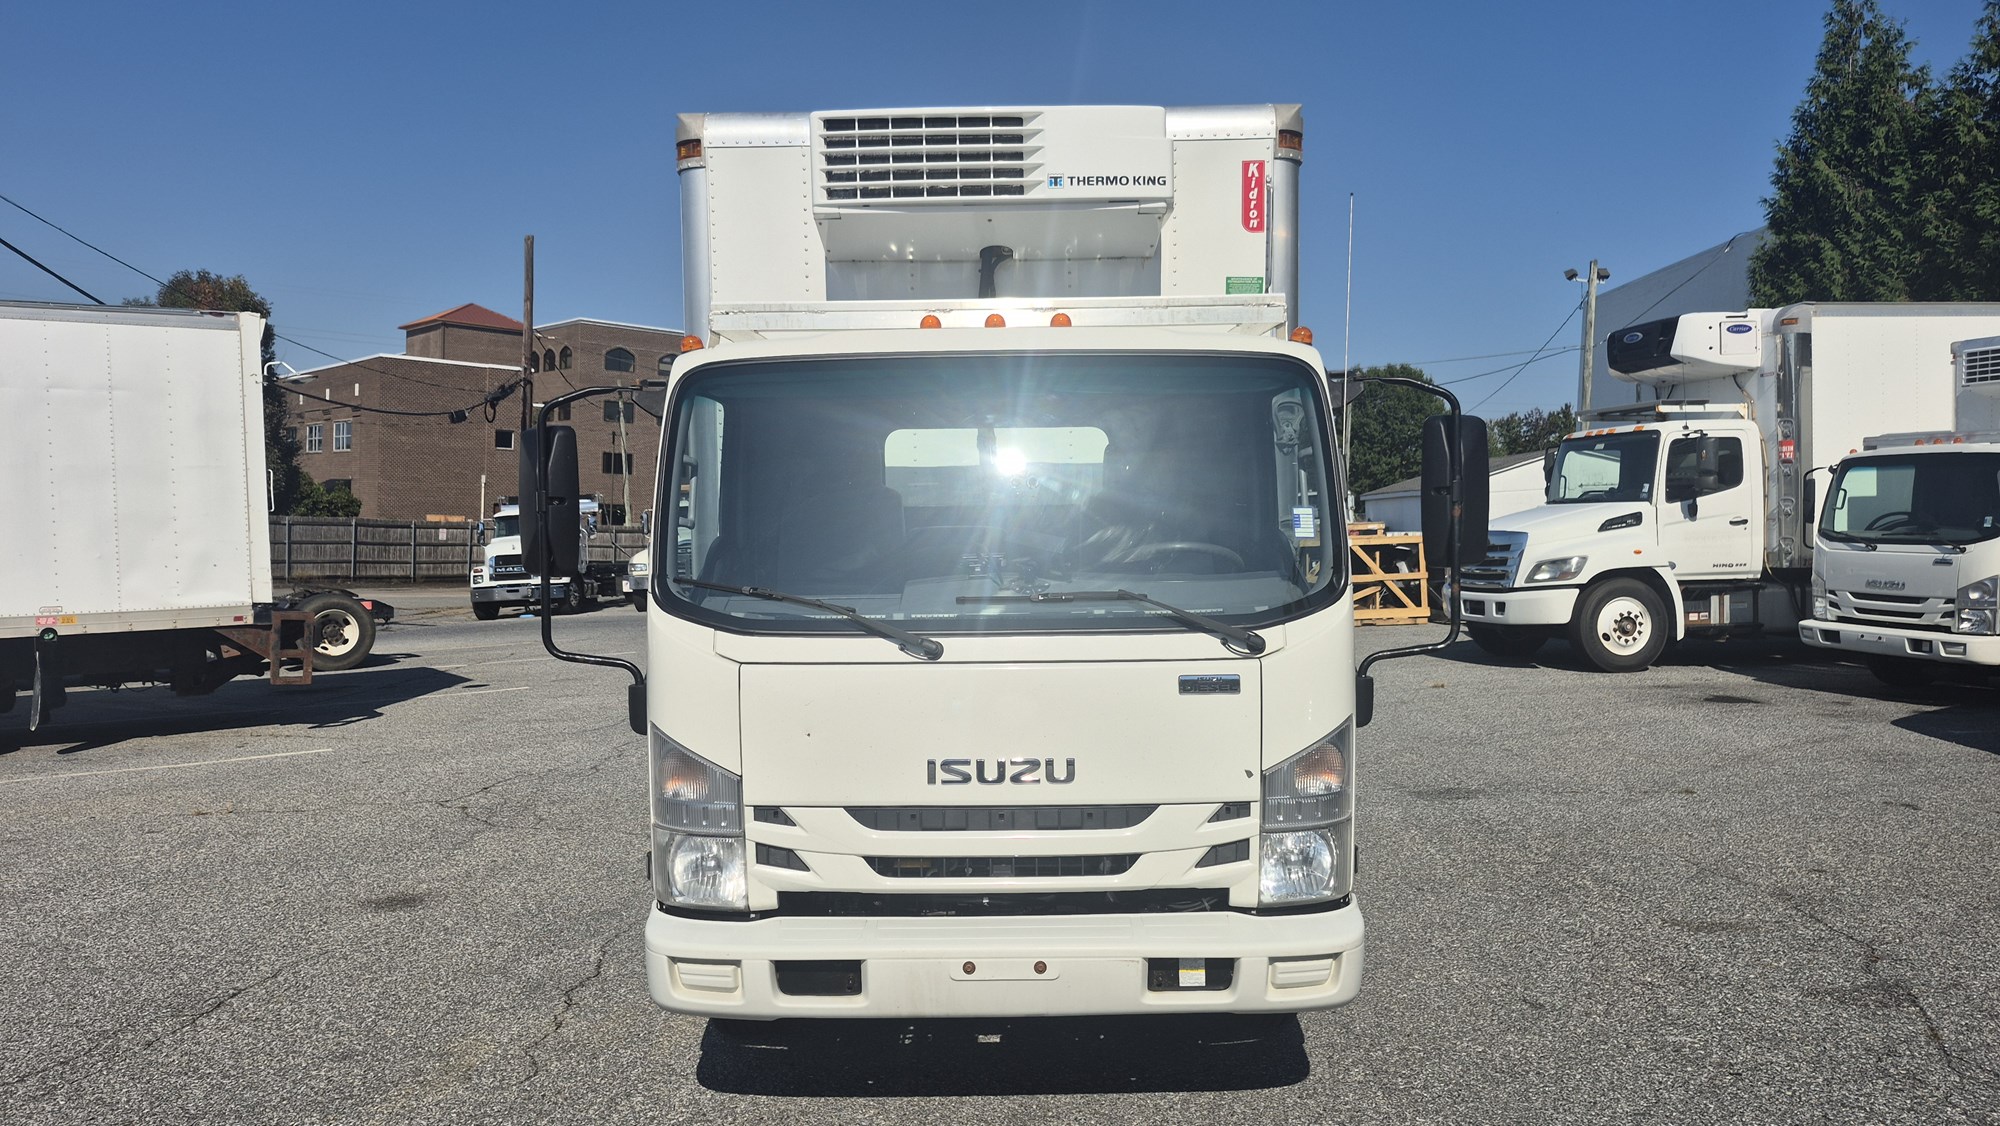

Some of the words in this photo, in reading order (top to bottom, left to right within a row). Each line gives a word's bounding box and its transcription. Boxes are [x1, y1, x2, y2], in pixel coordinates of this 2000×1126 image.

[1067, 175, 1130, 186] THERMO
[1132, 175, 1167, 186] KING
[1247, 162, 1260, 228] Kidron
[927, 758, 1076, 786] ISUZU
